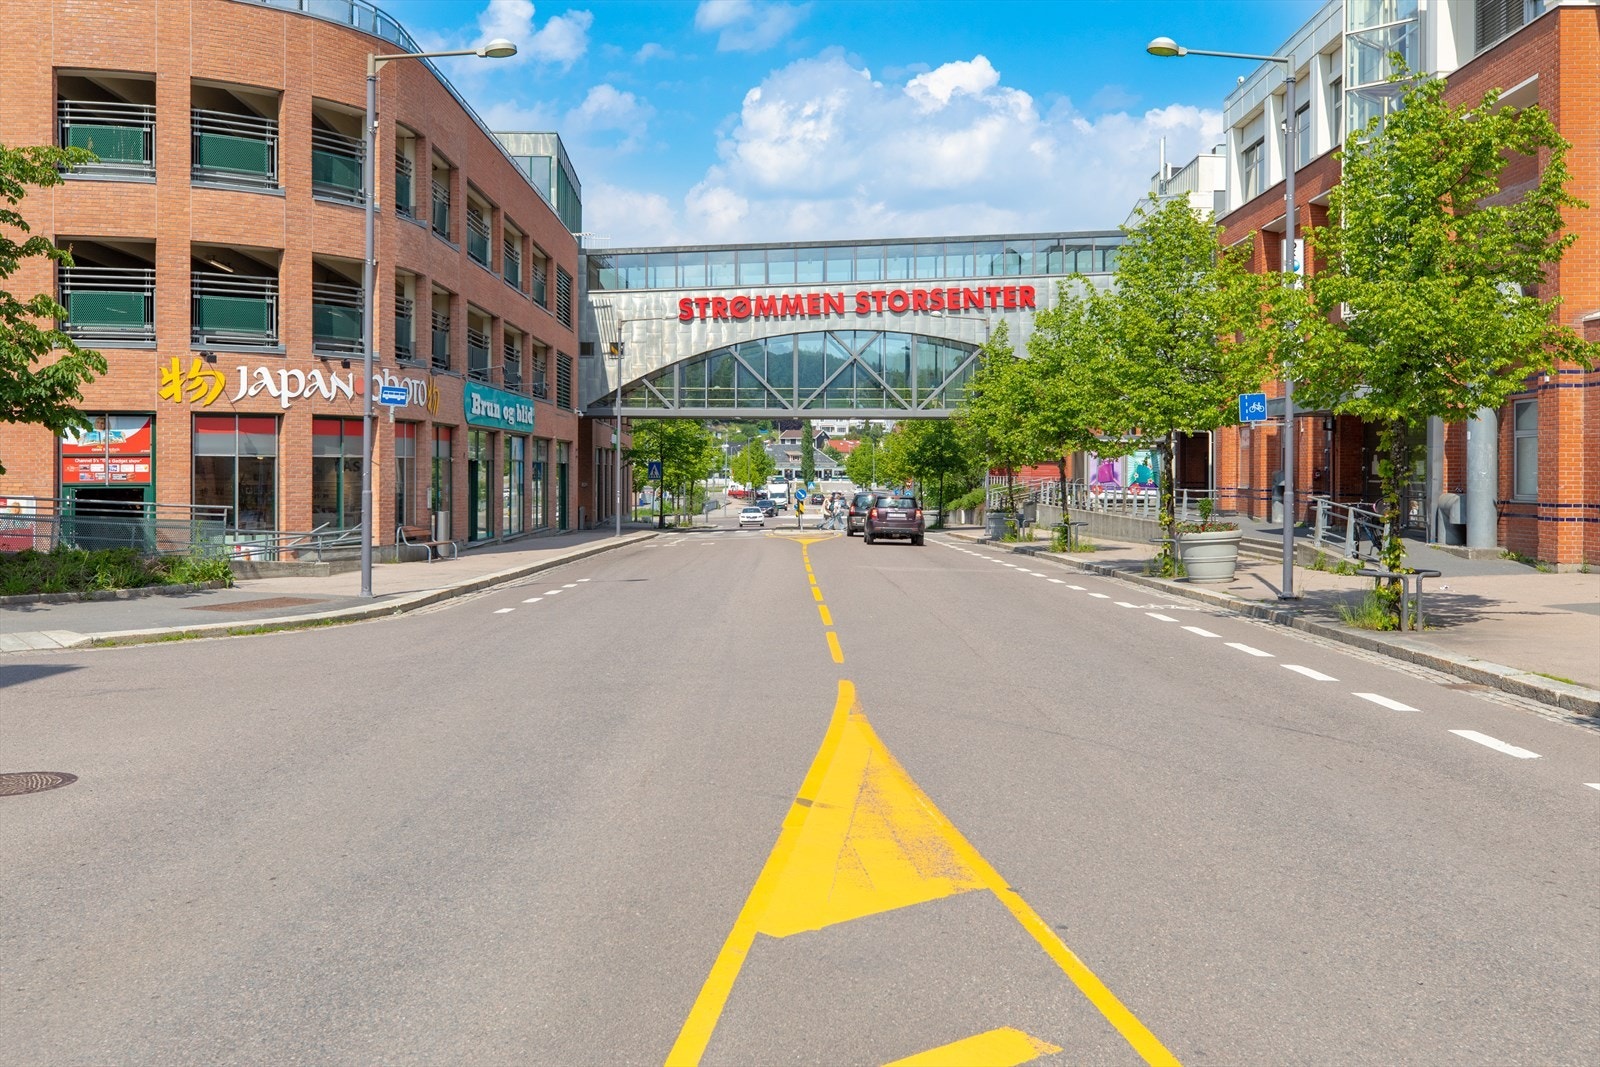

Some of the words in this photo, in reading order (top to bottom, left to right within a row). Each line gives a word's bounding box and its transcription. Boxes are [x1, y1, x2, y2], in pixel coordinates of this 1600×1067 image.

[678, 292, 845, 321] STRØMMEN
[855, 285, 1036, 315] STORSENTER
[158, 356, 227, 407] 物
[471, 392, 501, 420] Brun
[502, 405, 515, 426] og
[515, 403, 534, 425] blid
